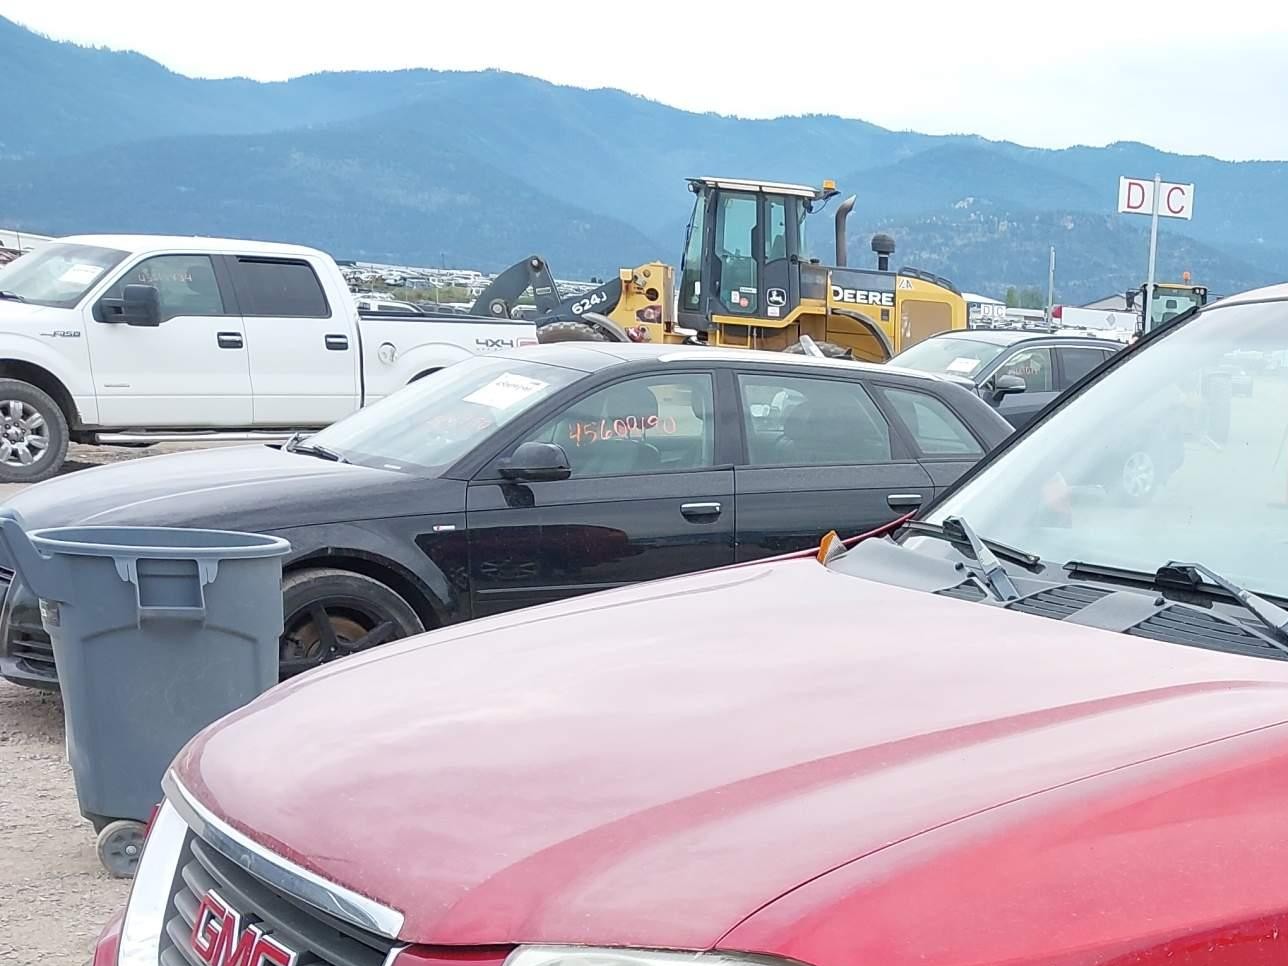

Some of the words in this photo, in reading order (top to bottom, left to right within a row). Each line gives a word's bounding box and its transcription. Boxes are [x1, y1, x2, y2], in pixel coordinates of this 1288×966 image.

[1126, 181, 1146, 210] D
[1166, 186, 1186, 214] C
[571, 293, 608, 315] 624J
[831, 285, 895, 307] DEERE
